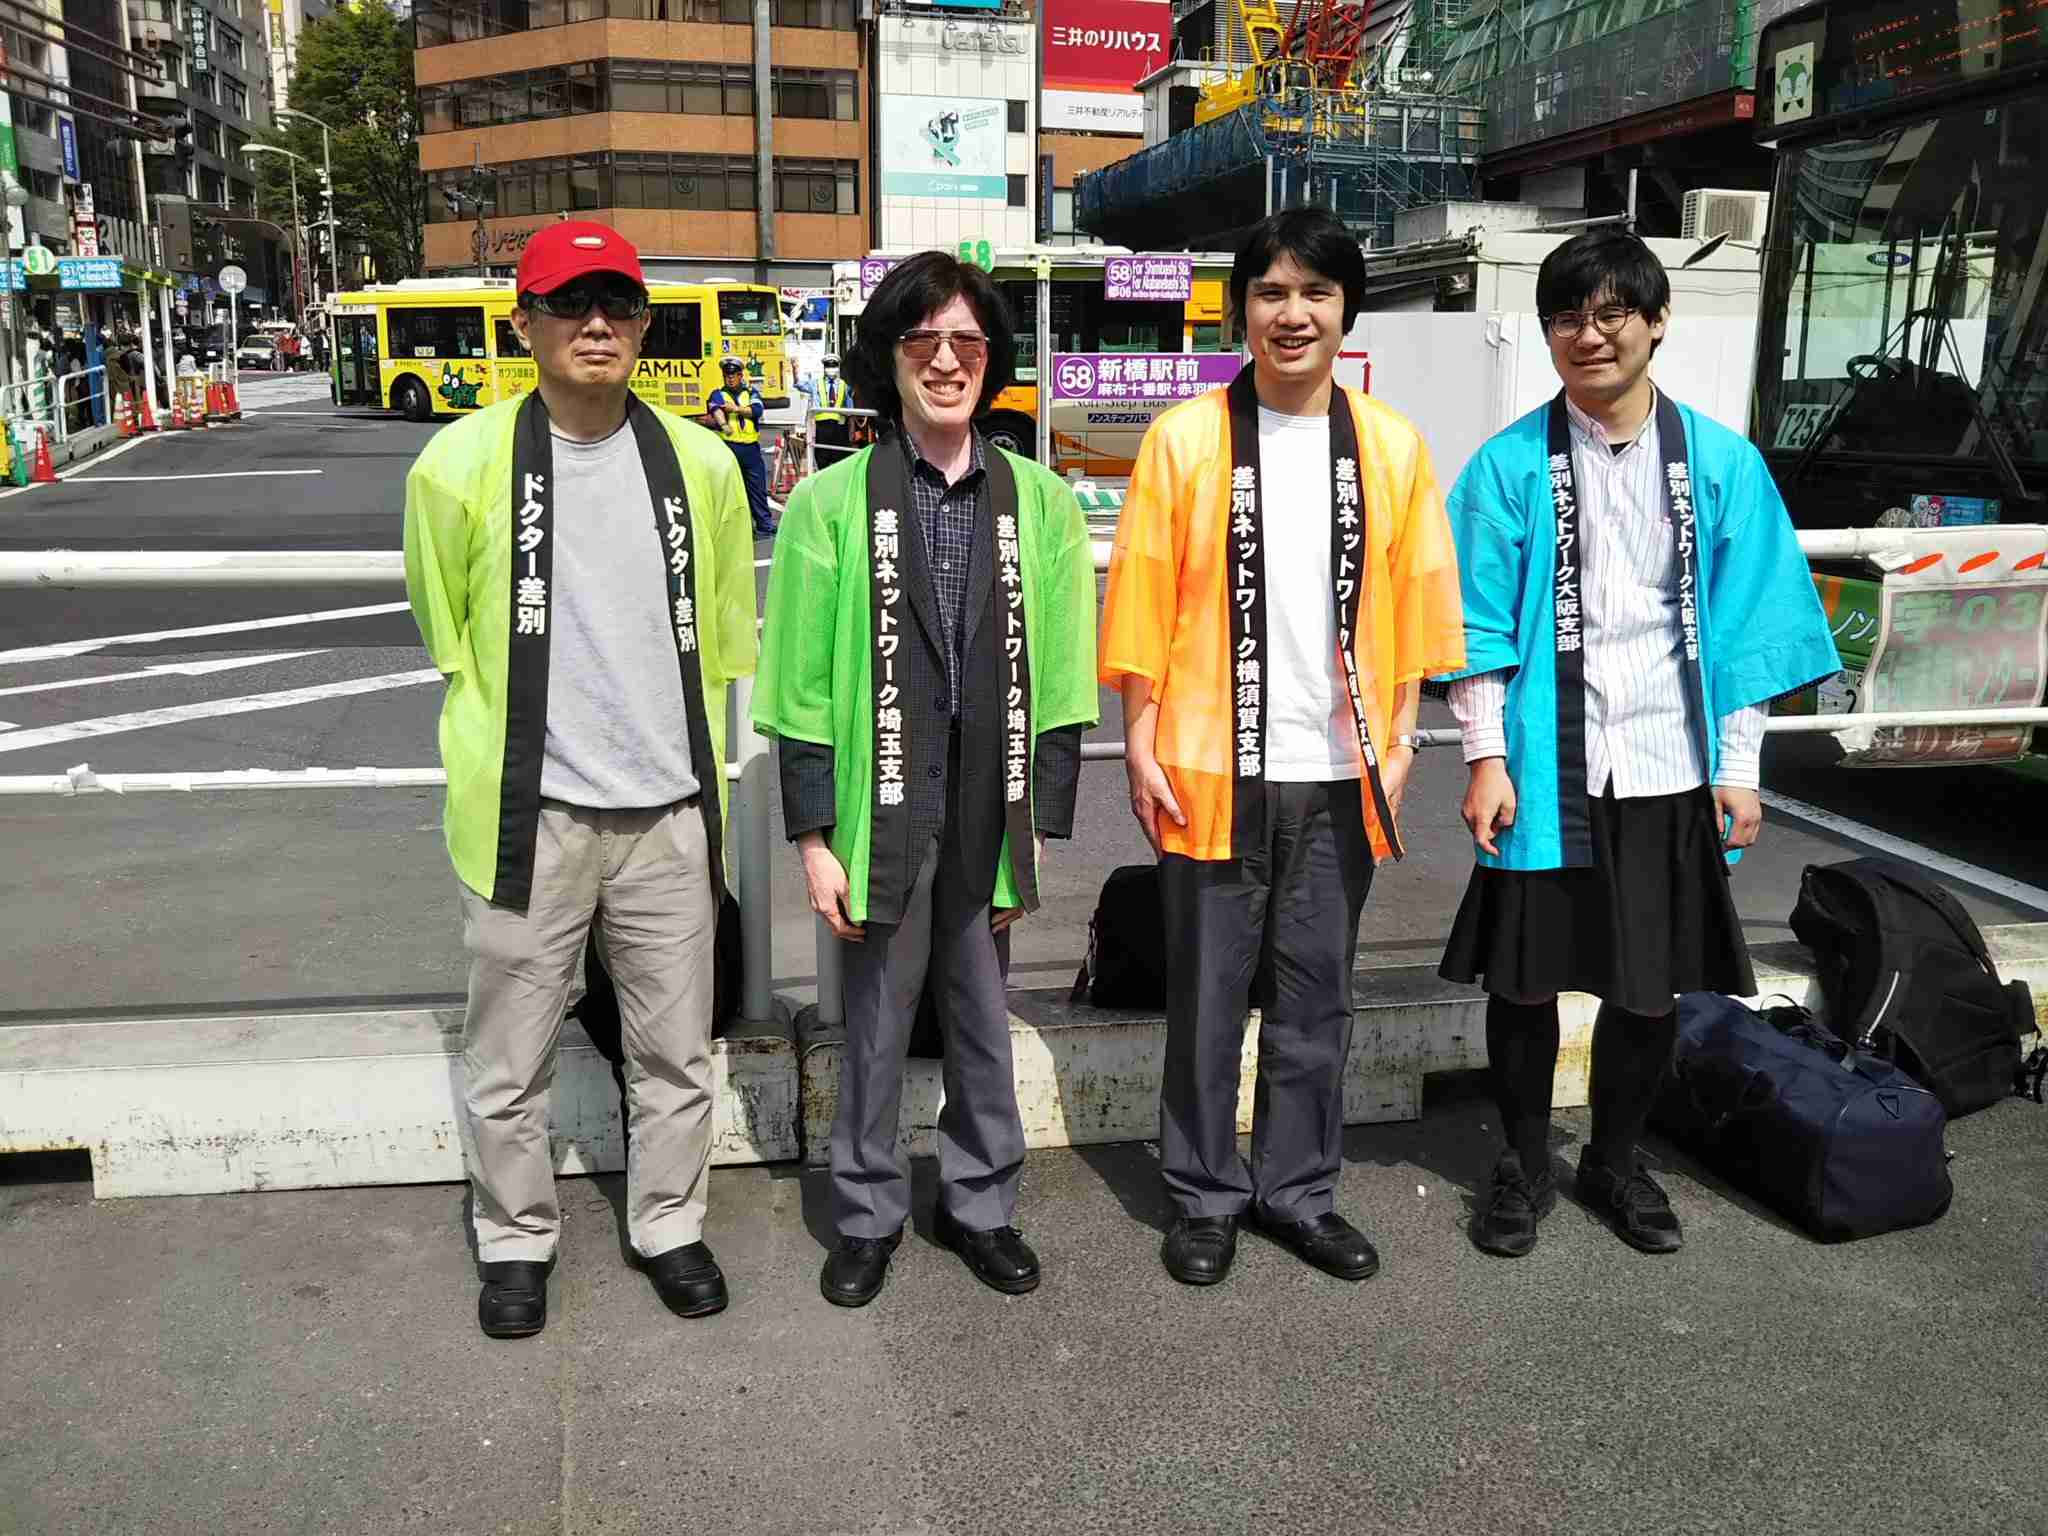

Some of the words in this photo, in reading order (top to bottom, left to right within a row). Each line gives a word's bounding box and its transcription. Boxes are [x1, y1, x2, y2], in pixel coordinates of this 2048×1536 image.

[1052, 26, 1161, 52] 三井のリハウス
[1110, 265, 1130, 281] 58
[1062, 365, 1092, 389] 58
[1098, 358, 1200, 382] 新橋駅前
[516, 472, 547, 635] ドクター差別
[664, 496, 697, 652] ドクター差別
[1231, 466, 1262, 778] 差別ネットワーク横須賀支部
[1548, 453, 1582, 653] 差別ネットワーク大阪支部
[1666, 462, 1698, 661] 差別ネットワーク大阪支部
[873, 508, 904, 806] 差別ネットワーク埼玉支部
[996, 514, 1026, 802] 差別ネットワーク埼玉支部
